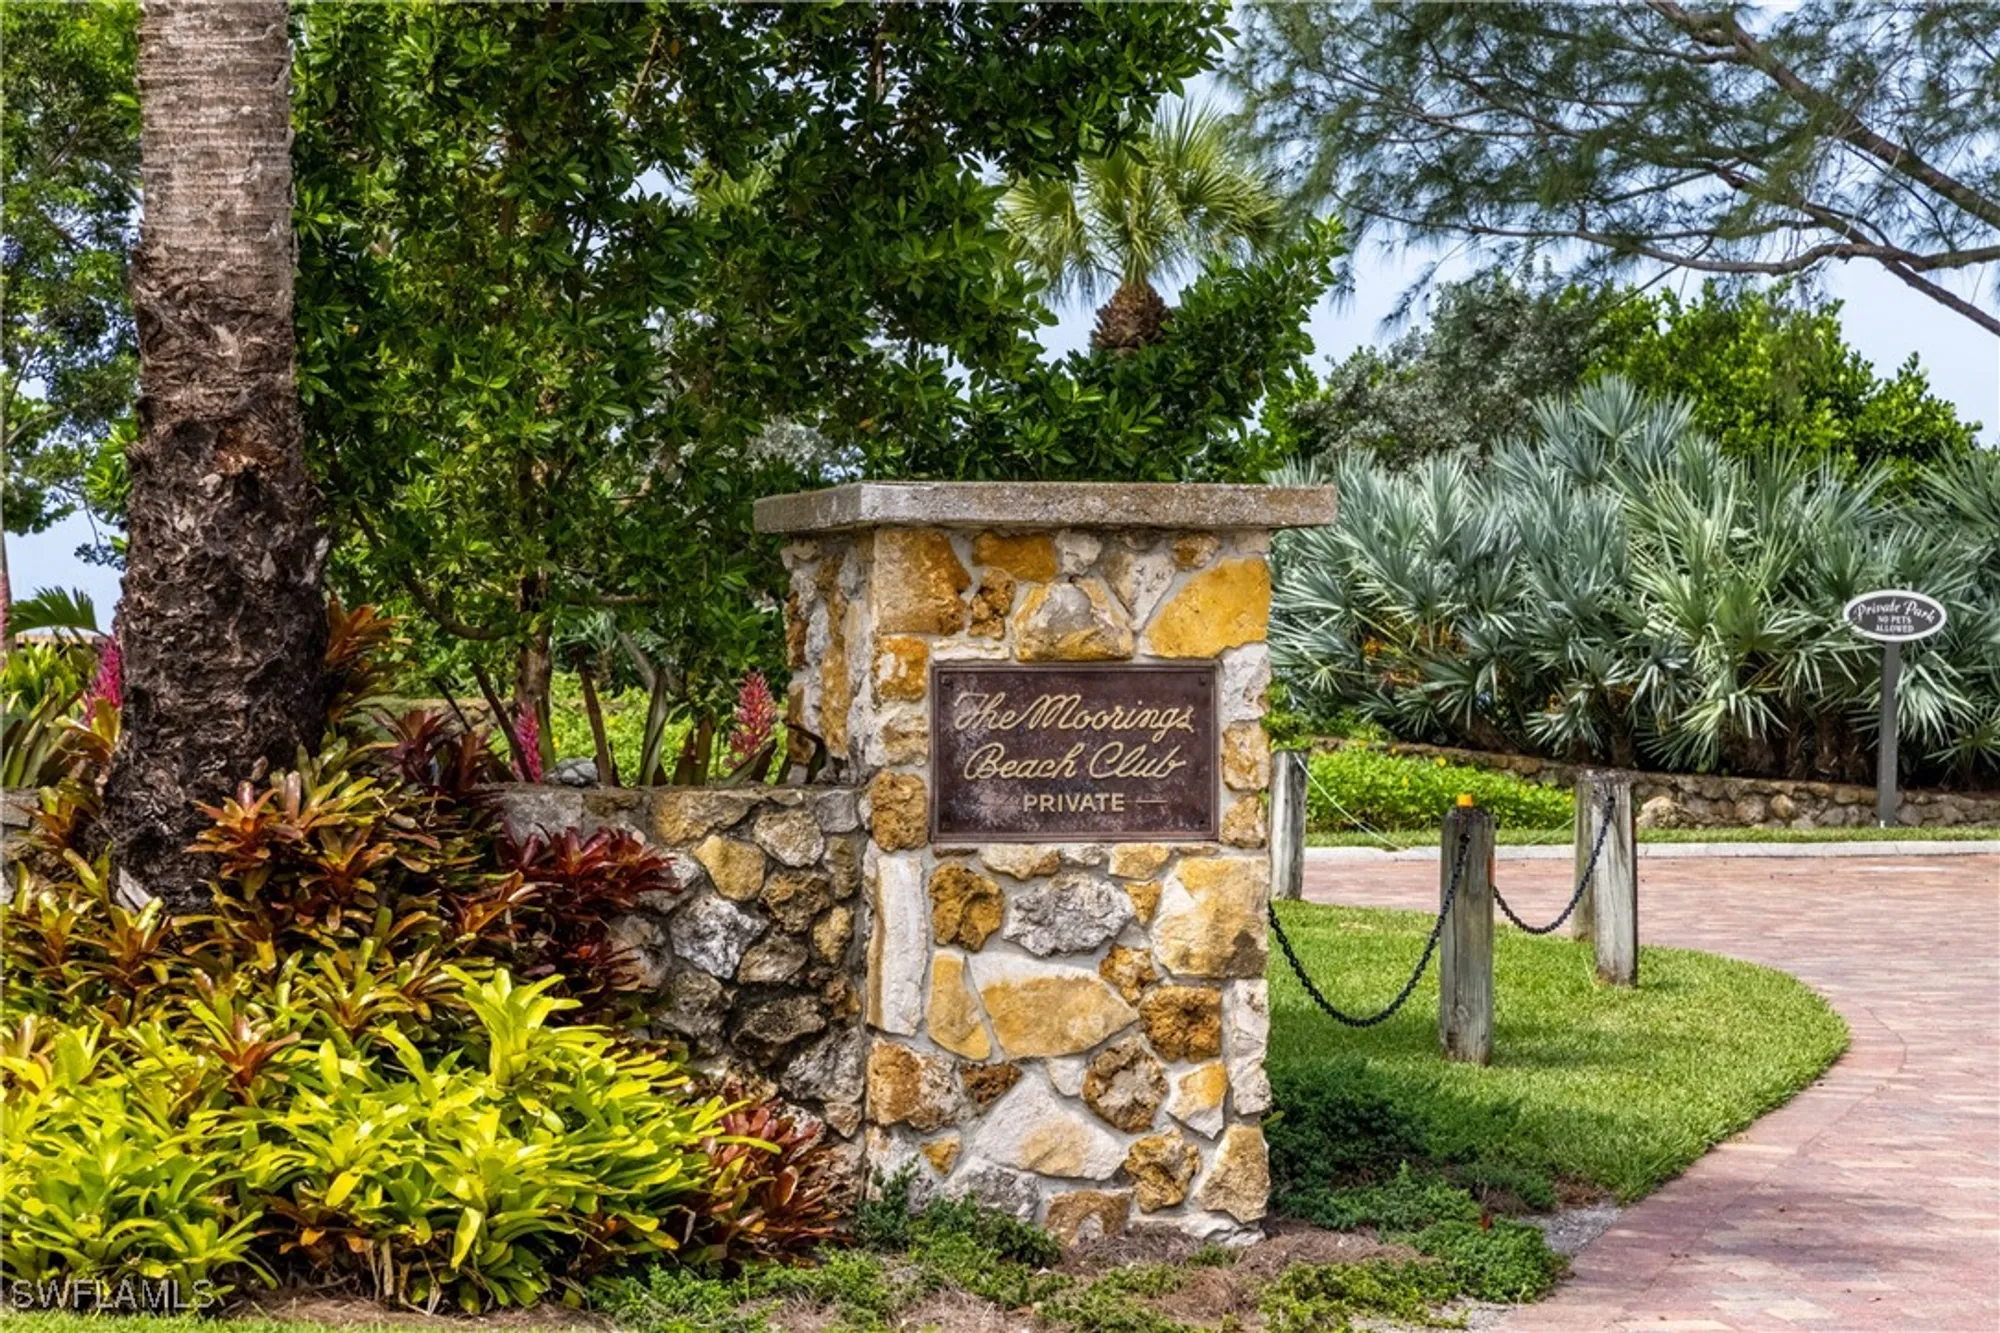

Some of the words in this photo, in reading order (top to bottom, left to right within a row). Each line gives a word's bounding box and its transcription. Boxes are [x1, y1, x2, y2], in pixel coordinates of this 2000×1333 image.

[1854, 599, 1901, 619] Private
[1903, 600, 1935, 623] Park
[1878, 615, 1888, 624] NO
[1891, 615, 1912, 624] PETS
[1875, 625, 1914, 633] ALLOWED
[953, 692, 1022, 730] The
[1027, 694, 1195, 743] Moorings
[963, 742, 1086, 780] Beach
[1089, 741, 1187, 779] Club
[1023, 793, 1126, 813] PRIVATE
